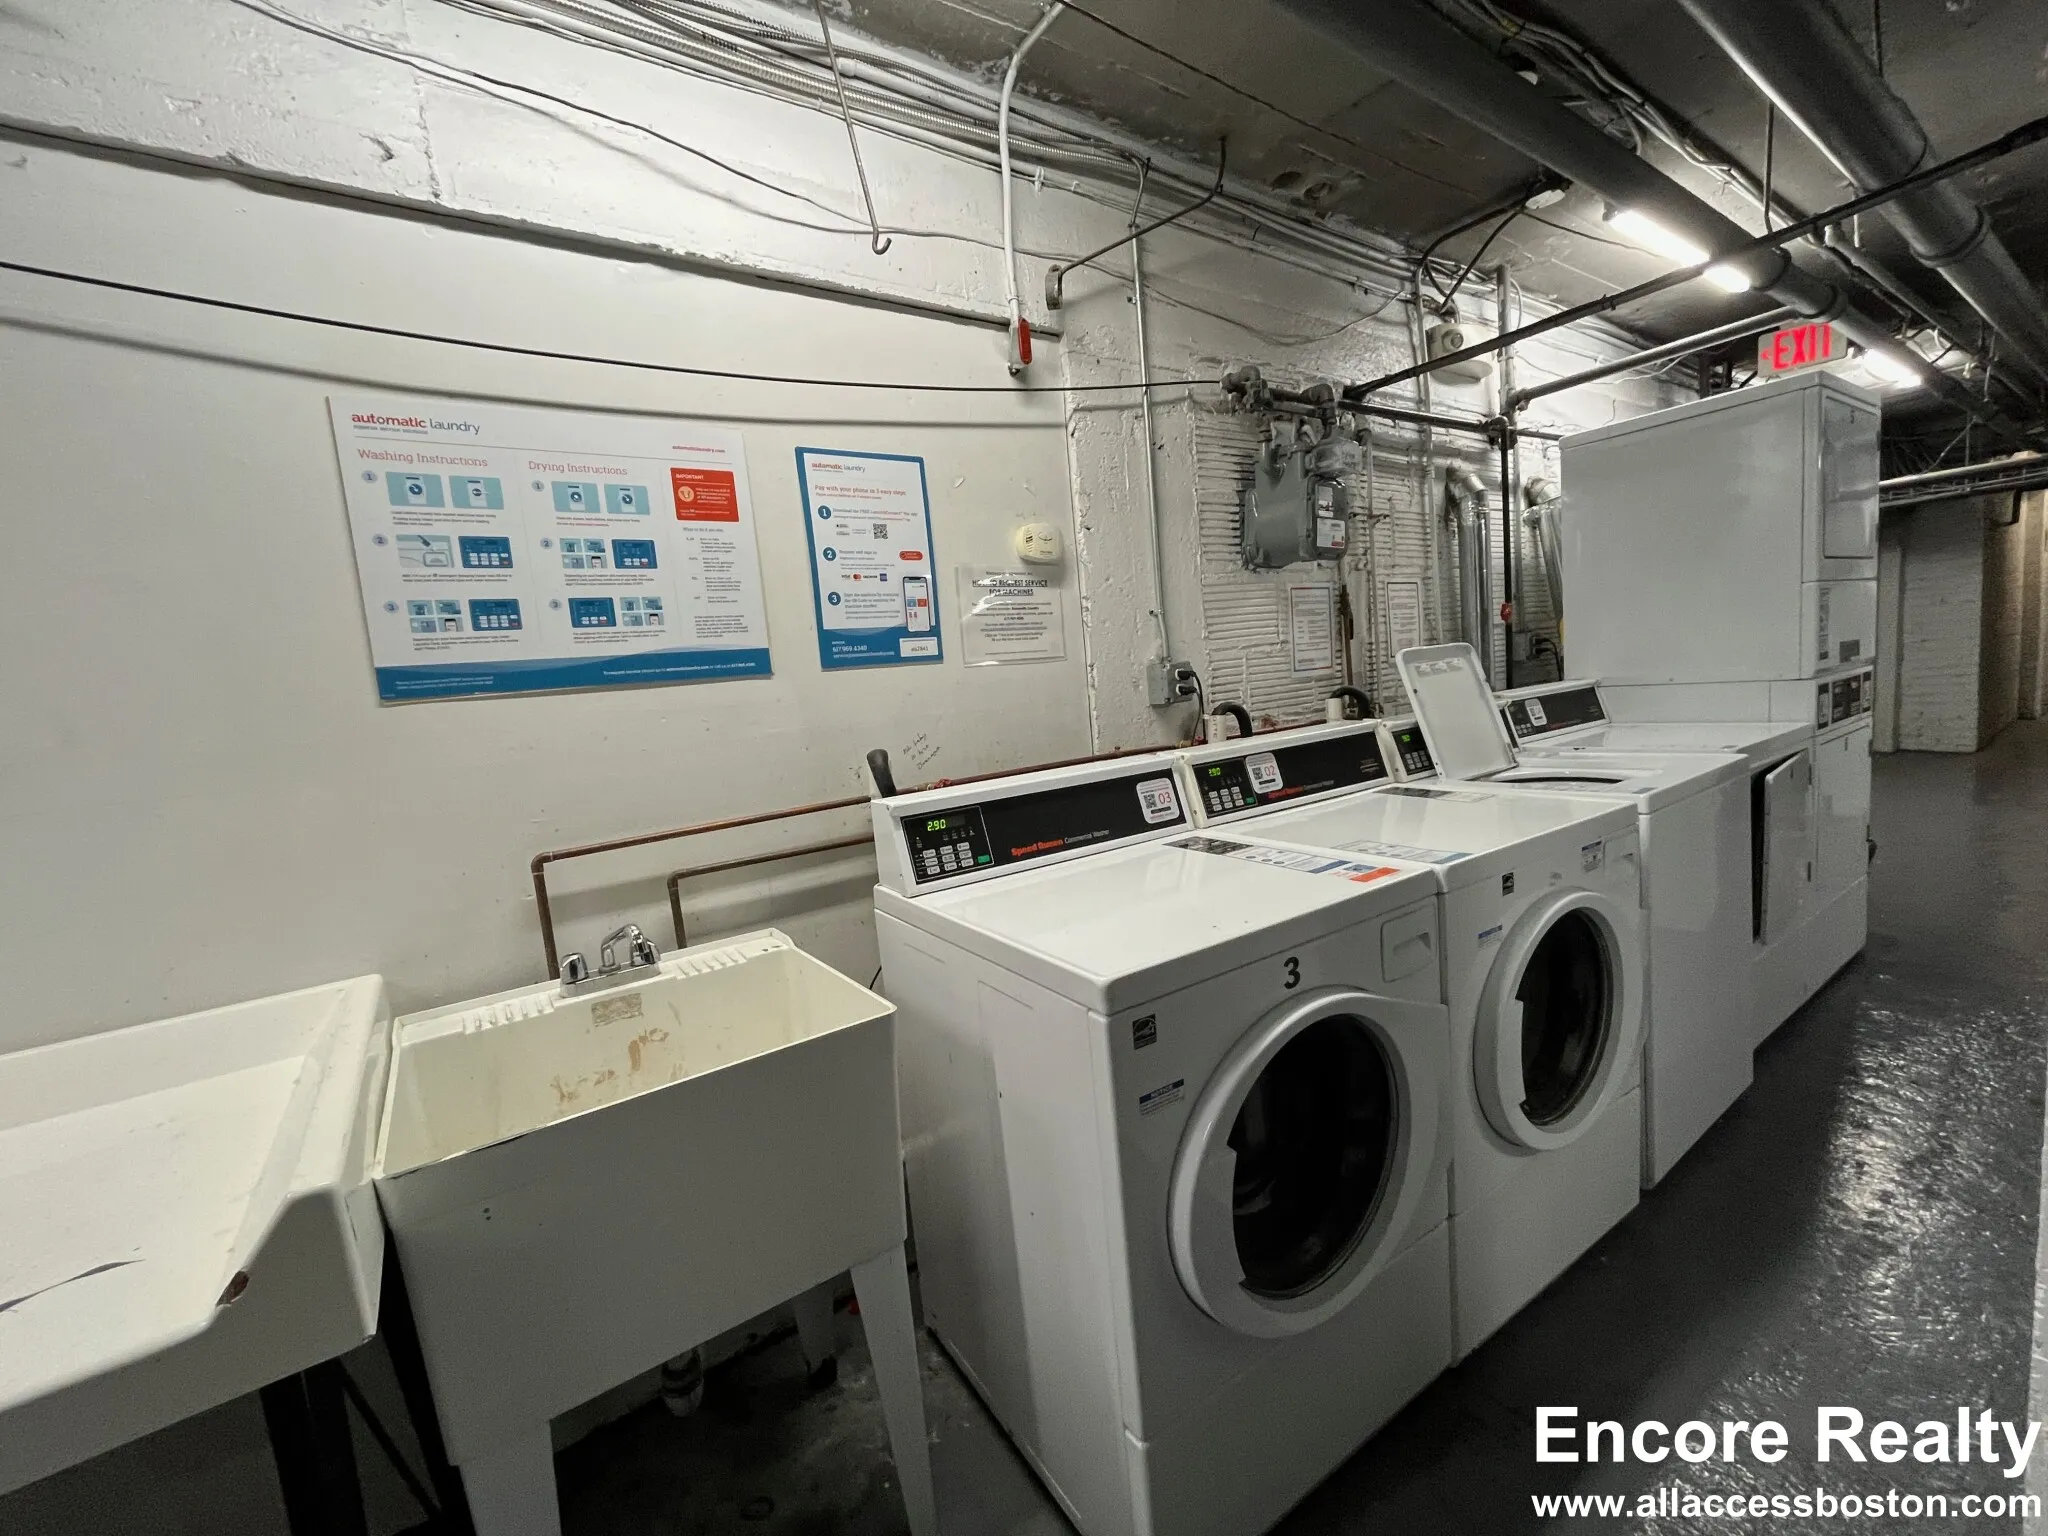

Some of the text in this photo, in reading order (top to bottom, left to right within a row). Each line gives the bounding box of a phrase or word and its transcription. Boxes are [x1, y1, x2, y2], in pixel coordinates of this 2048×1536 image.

[1773, 322, 1832, 370] EXIT
[352, 413, 427, 429] automatic
[429, 418, 481, 435] laundry
[357, 448, 488, 467] Washing Instructions
[528, 460, 628, 475] Drying Instructions
[811, 462, 843, 470] automatic
[843, 465, 866, 473] laundry
[999, 579, 1024, 587] REQUEST
[1025, 579, 1048, 587] SERVICE
[1002, 588, 1034, 596] MACHINES
[1263, 765, 1277, 777] 02
[1158, 791, 1172, 805] 03
[1010, 843, 1038, 856] Speed
[1038, 839, 1064, 850] Queen
[1283, 956, 1301, 990] 3
